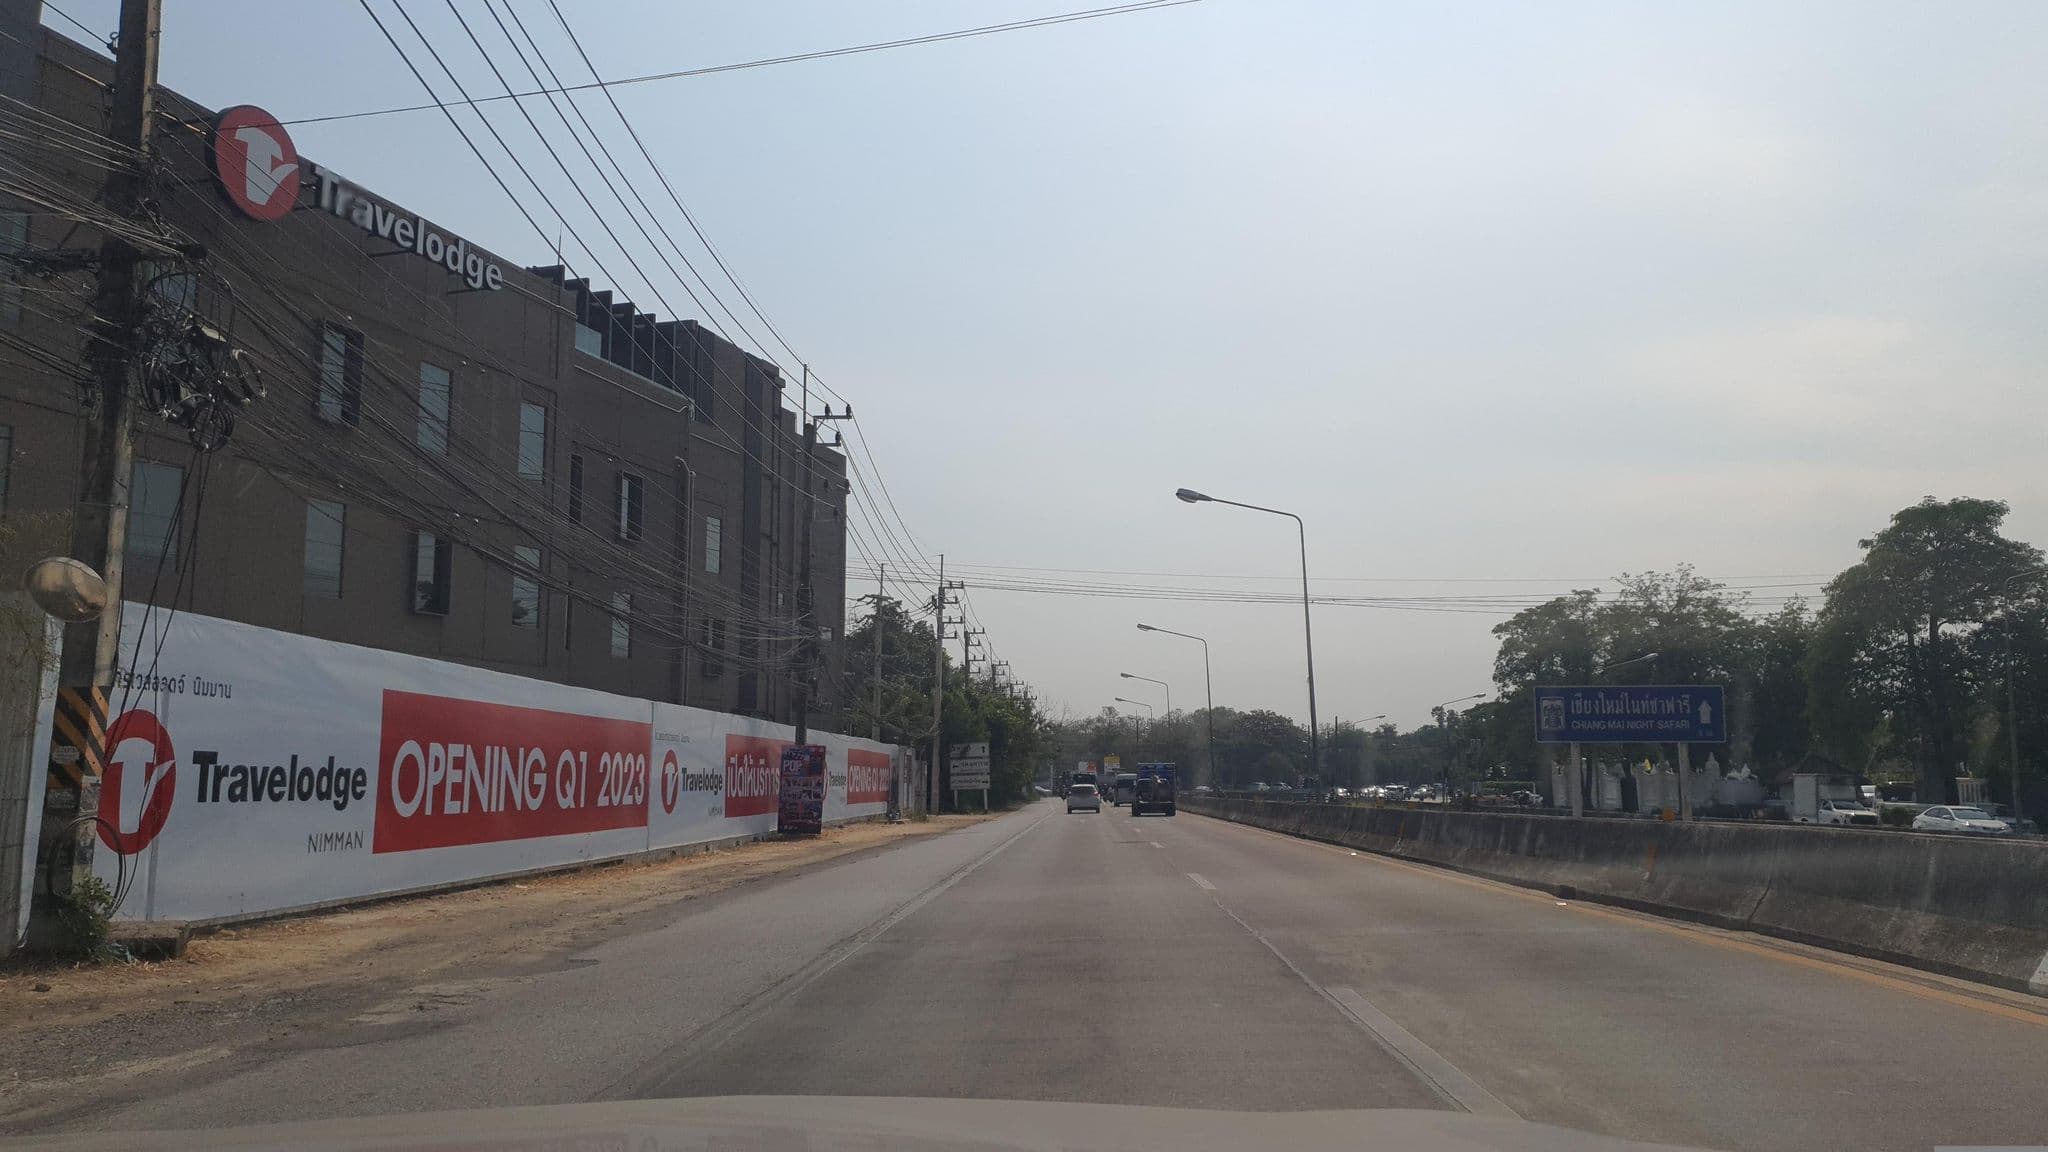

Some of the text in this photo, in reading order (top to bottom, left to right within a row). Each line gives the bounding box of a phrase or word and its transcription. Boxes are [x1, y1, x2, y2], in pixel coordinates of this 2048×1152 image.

[315, 165, 503, 290] Travelodge
[193, 676, 232, 698] นิมมาน
[1571, 719, 1690, 730] CHIANG MAI NIGHT SAFARI
[192, 750, 367, 811] Travelodge
[391, 739, 646, 818] OPENING Q1 2023
[681, 767, 722, 796] Travelodge
[307, 831, 364, 854] NIMMAN
